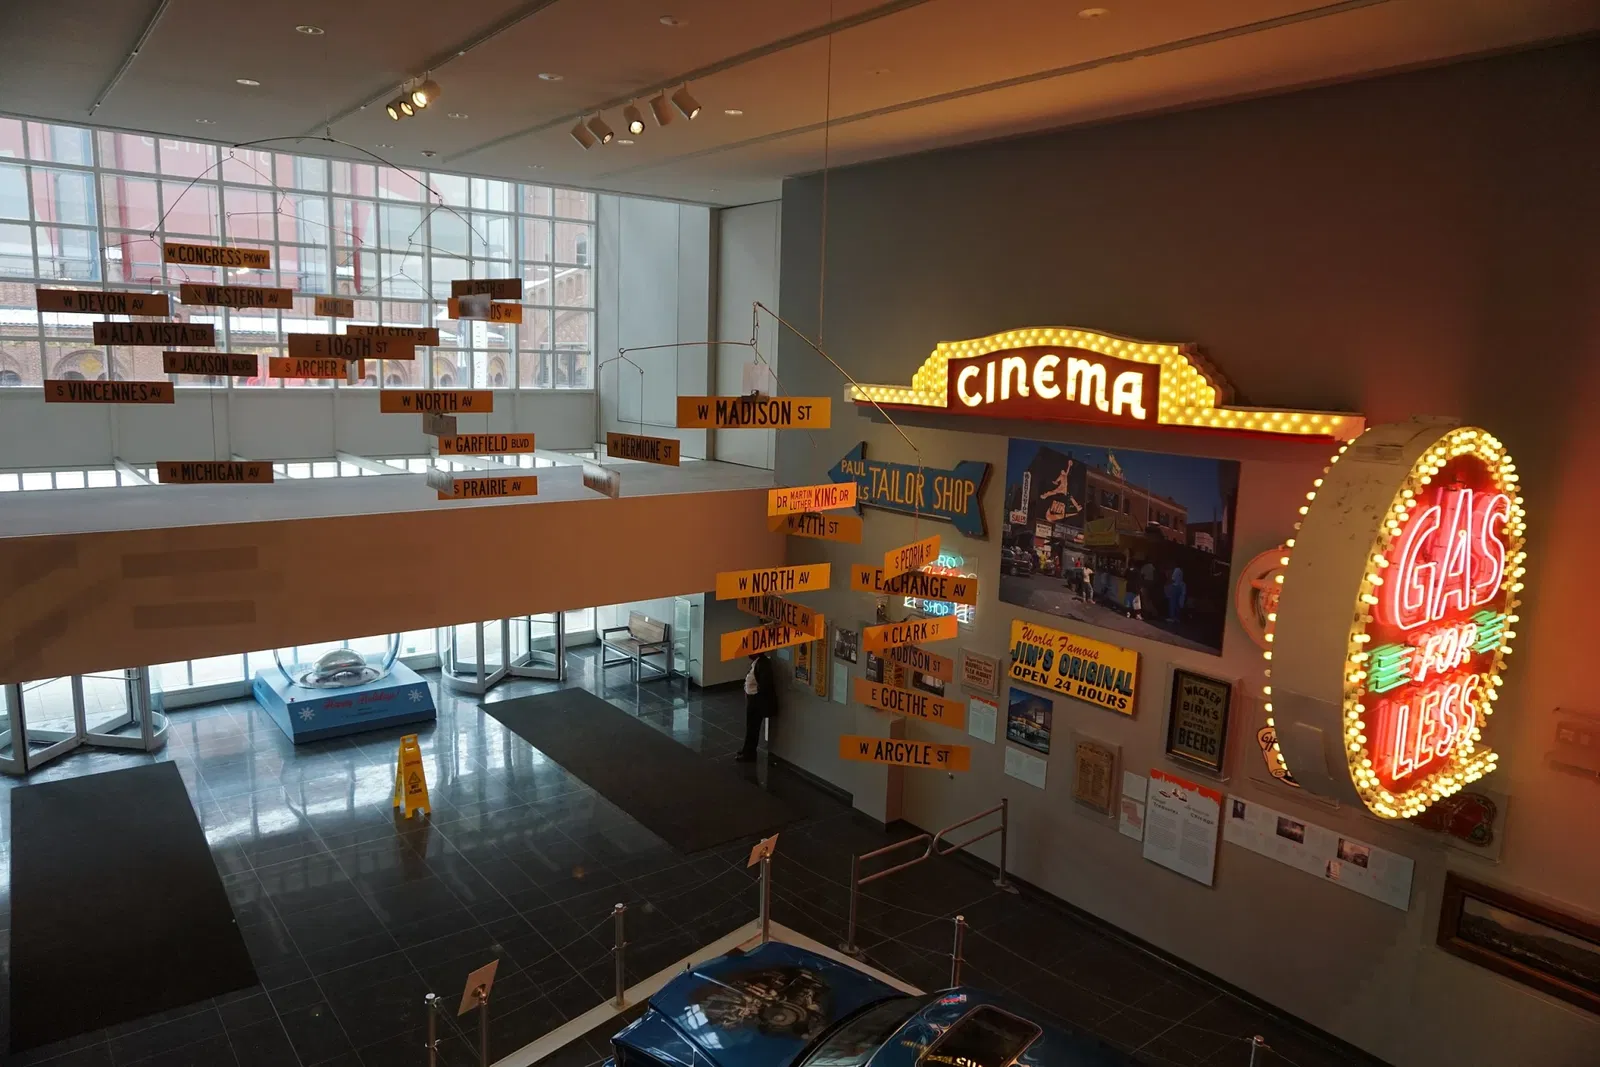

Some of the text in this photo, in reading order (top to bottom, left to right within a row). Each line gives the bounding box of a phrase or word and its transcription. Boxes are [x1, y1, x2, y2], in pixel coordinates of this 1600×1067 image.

[167, 246, 266, 265] W CONGRESS PKWY
[63, 293, 144, 312] W DEVON AV
[205, 288, 264, 306] WESTERN
[268, 293, 279, 303] AV
[111, 325, 144, 343] ALTA
[150, 326, 188, 344] VISTA
[190, 331, 207, 341] TER
[417, 332, 427, 341] ST
[316, 337, 387, 357] E 106TH ST
[169, 356, 251, 373] W JACKSON BLVD
[285, 362, 291, 373] S
[295, 360, 338, 377] ARCHER
[56, 383, 161, 401] S VINCENNES AV
[957, 354, 1146, 420] CINEMA
[402, 393, 472, 410] W NORTH AV
[698, 400, 812, 426] W MADISON ST
[444, 436, 529, 453] W GARFIELD BLVD
[621, 437, 661, 461] HERMIONE
[663, 446, 672, 459] ST
[170, 464, 260, 481] N MICHIGAN AV
[841, 459, 866, 476] PAUL
[454, 484, 459, 494] S
[463, 480, 508, 496] PRAIRIE
[512, 481, 521, 491] AV
[790, 490, 812, 499] MARTIN
[814, 487, 837, 508] KING
[839, 489, 849, 502] DR
[869, 466, 925, 508] TAILOR
[933, 476, 975, 514] SHOP
[777, 496, 788, 508] DR
[790, 500, 812, 510] LUTHER
[788, 514, 839, 536] W 47TH ST
[895, 556, 899, 569] S
[900, 544, 924, 571] PEORIA
[926, 544, 932, 557] ST
[1395, 487, 1511, 631] GAS
[739, 570, 810, 594] W NORTH AV
[861, 572, 870, 584] W
[874, 570, 948, 598] EXCHANGE
[953, 584, 966, 597] AV
[748, 596, 798, 627] MILWAUKEE
[801, 613, 810, 626] AV
[923, 600, 949, 615] SHOP
[742, 637, 748, 649] N
[753, 626, 790, 651] DAMEN
[884, 623, 939, 644] N CLARK ST
[1022, 626, 1100, 660] World Famous
[890, 646, 930, 672] ADDISON
[933, 661, 941, 673] ST
[1415, 622, 1478, 682] FOR
[1012, 641, 1133, 697] JIM'S ORIGINAL
[1013, 665, 1128, 710] OPEN 24 HOURS
[1184, 685, 1222, 706] WACKER
[872, 687, 944, 718] E GOETHE ST
[1183, 701, 1219, 720] BIRK'S
[1392, 674, 1479, 781] LESS
[859, 740, 950, 765] W ARGYLE ST
[1178, 728, 1217, 756] BEERS
